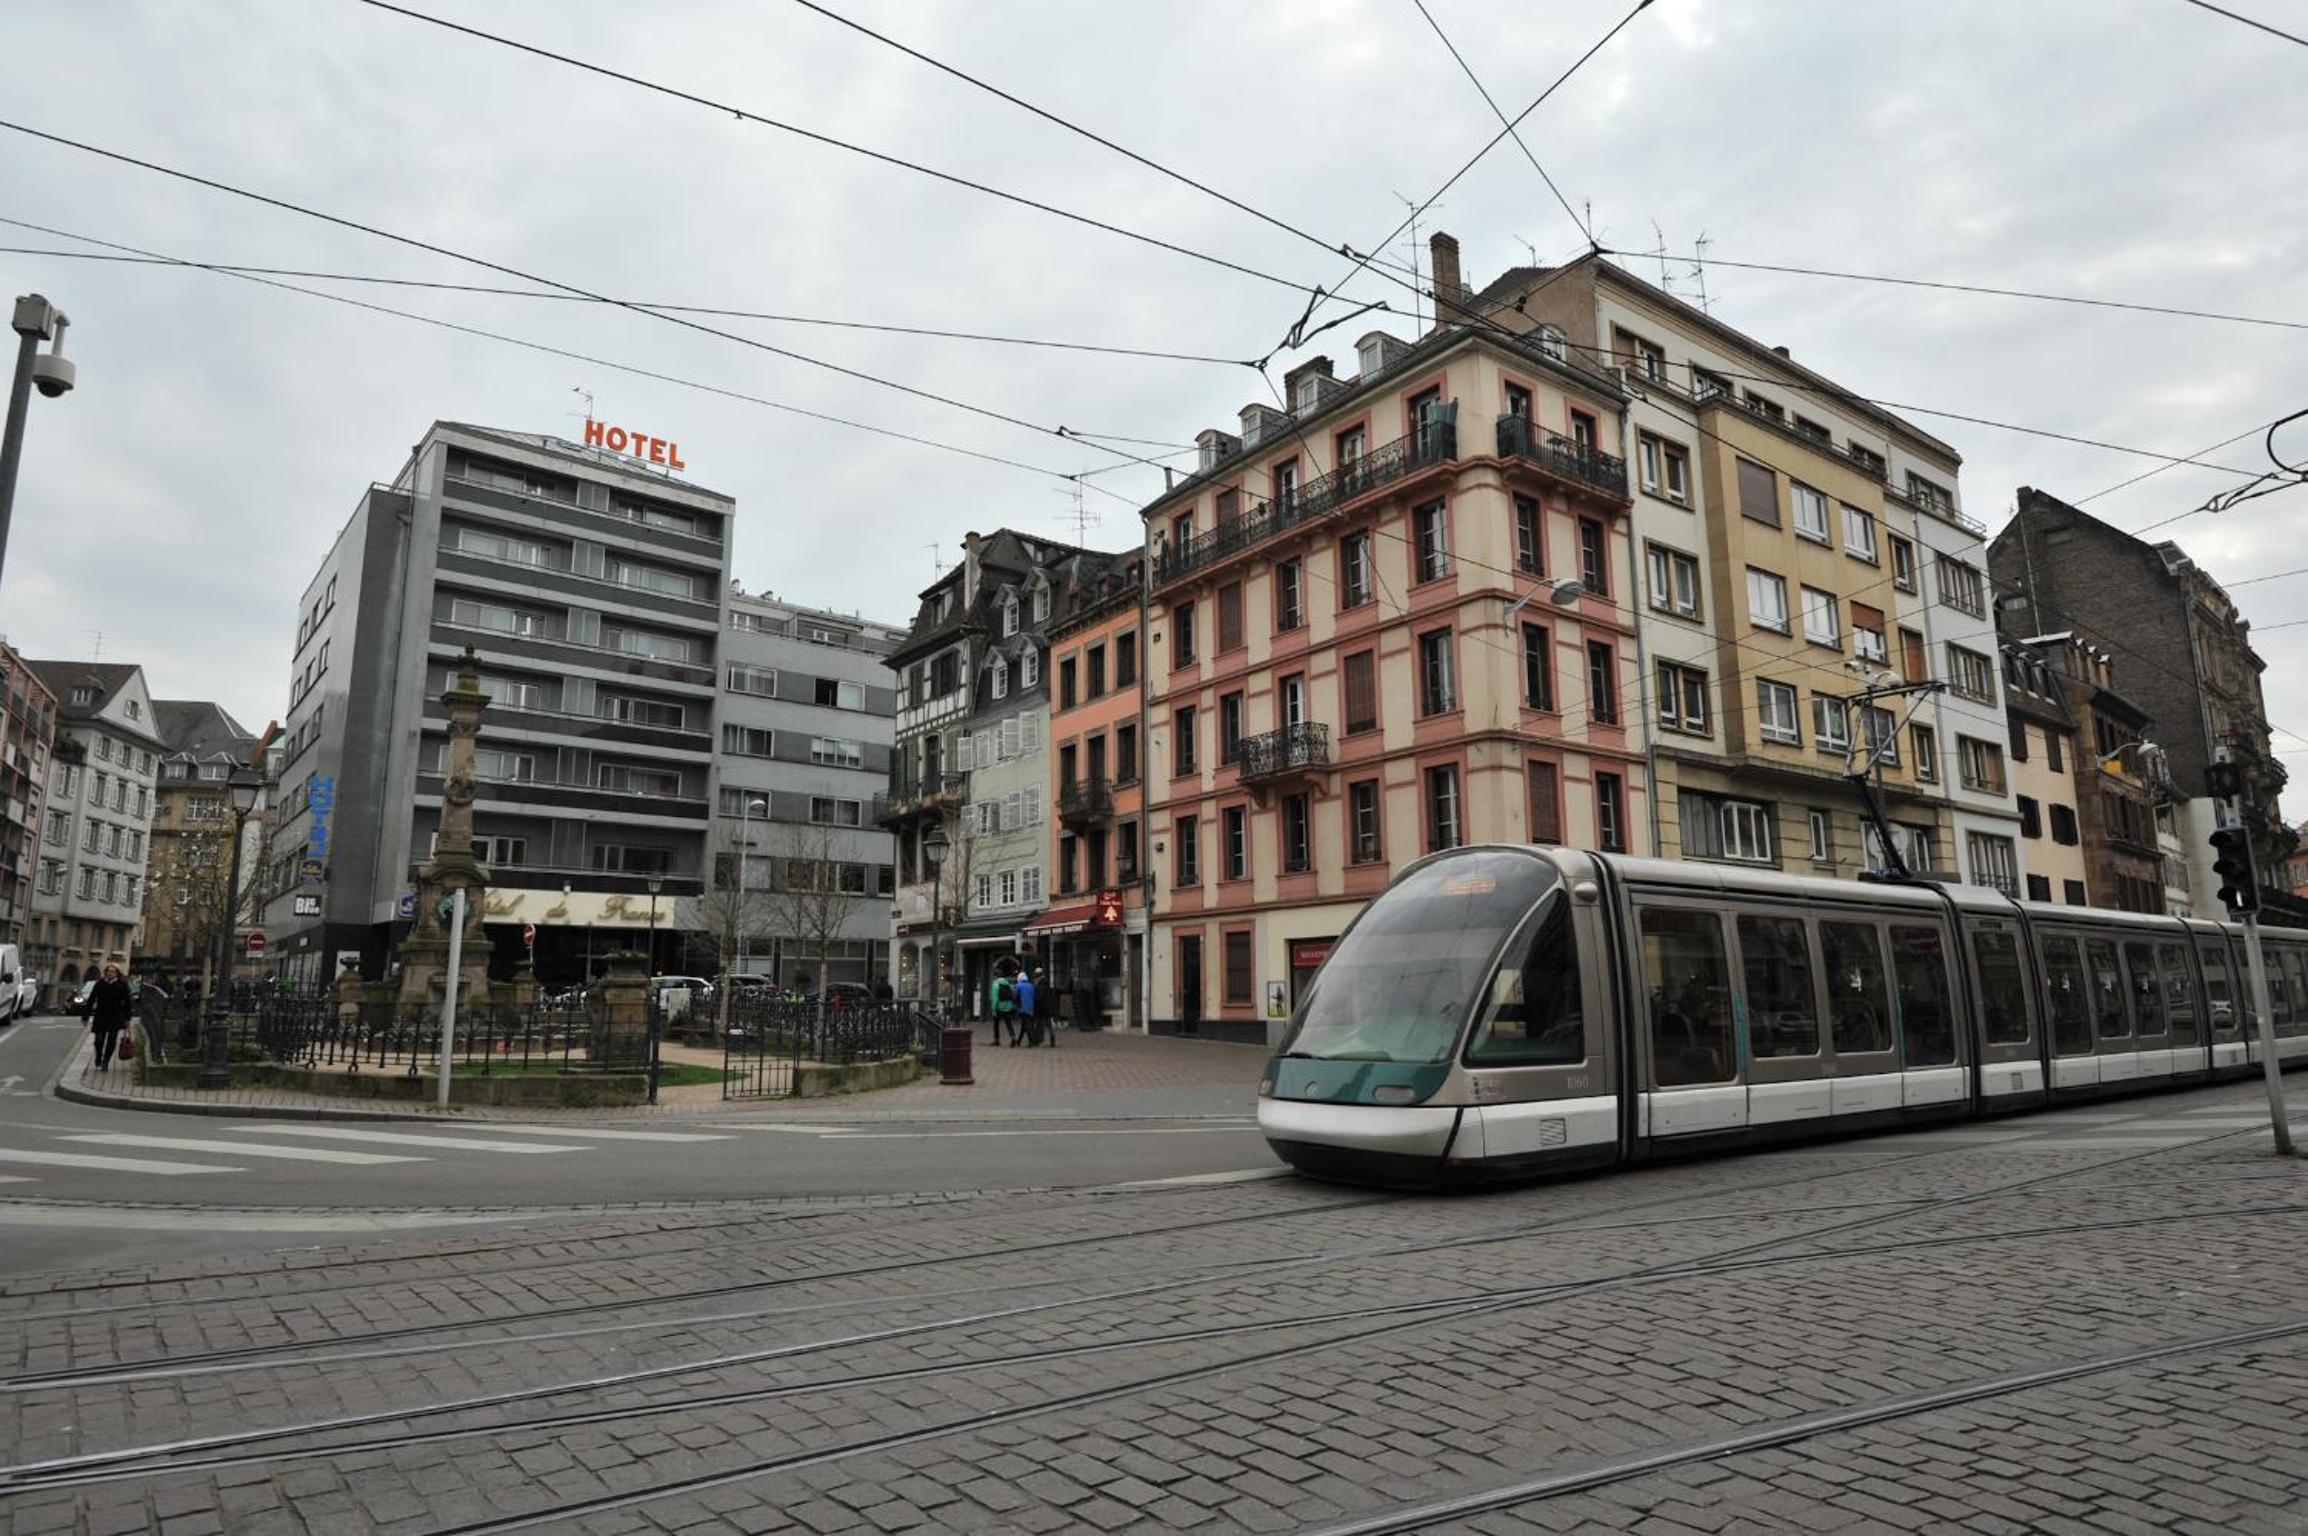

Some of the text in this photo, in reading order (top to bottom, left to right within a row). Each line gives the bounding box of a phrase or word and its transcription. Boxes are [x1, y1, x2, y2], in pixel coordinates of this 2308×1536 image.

[585, 419, 685, 469] HOTEL
[307, 776, 335, 858] HOTEL
[546, 901, 568, 918] de
[598, 896, 666, 922] Frane
[1567, 1076, 1589, 1089] 1060
